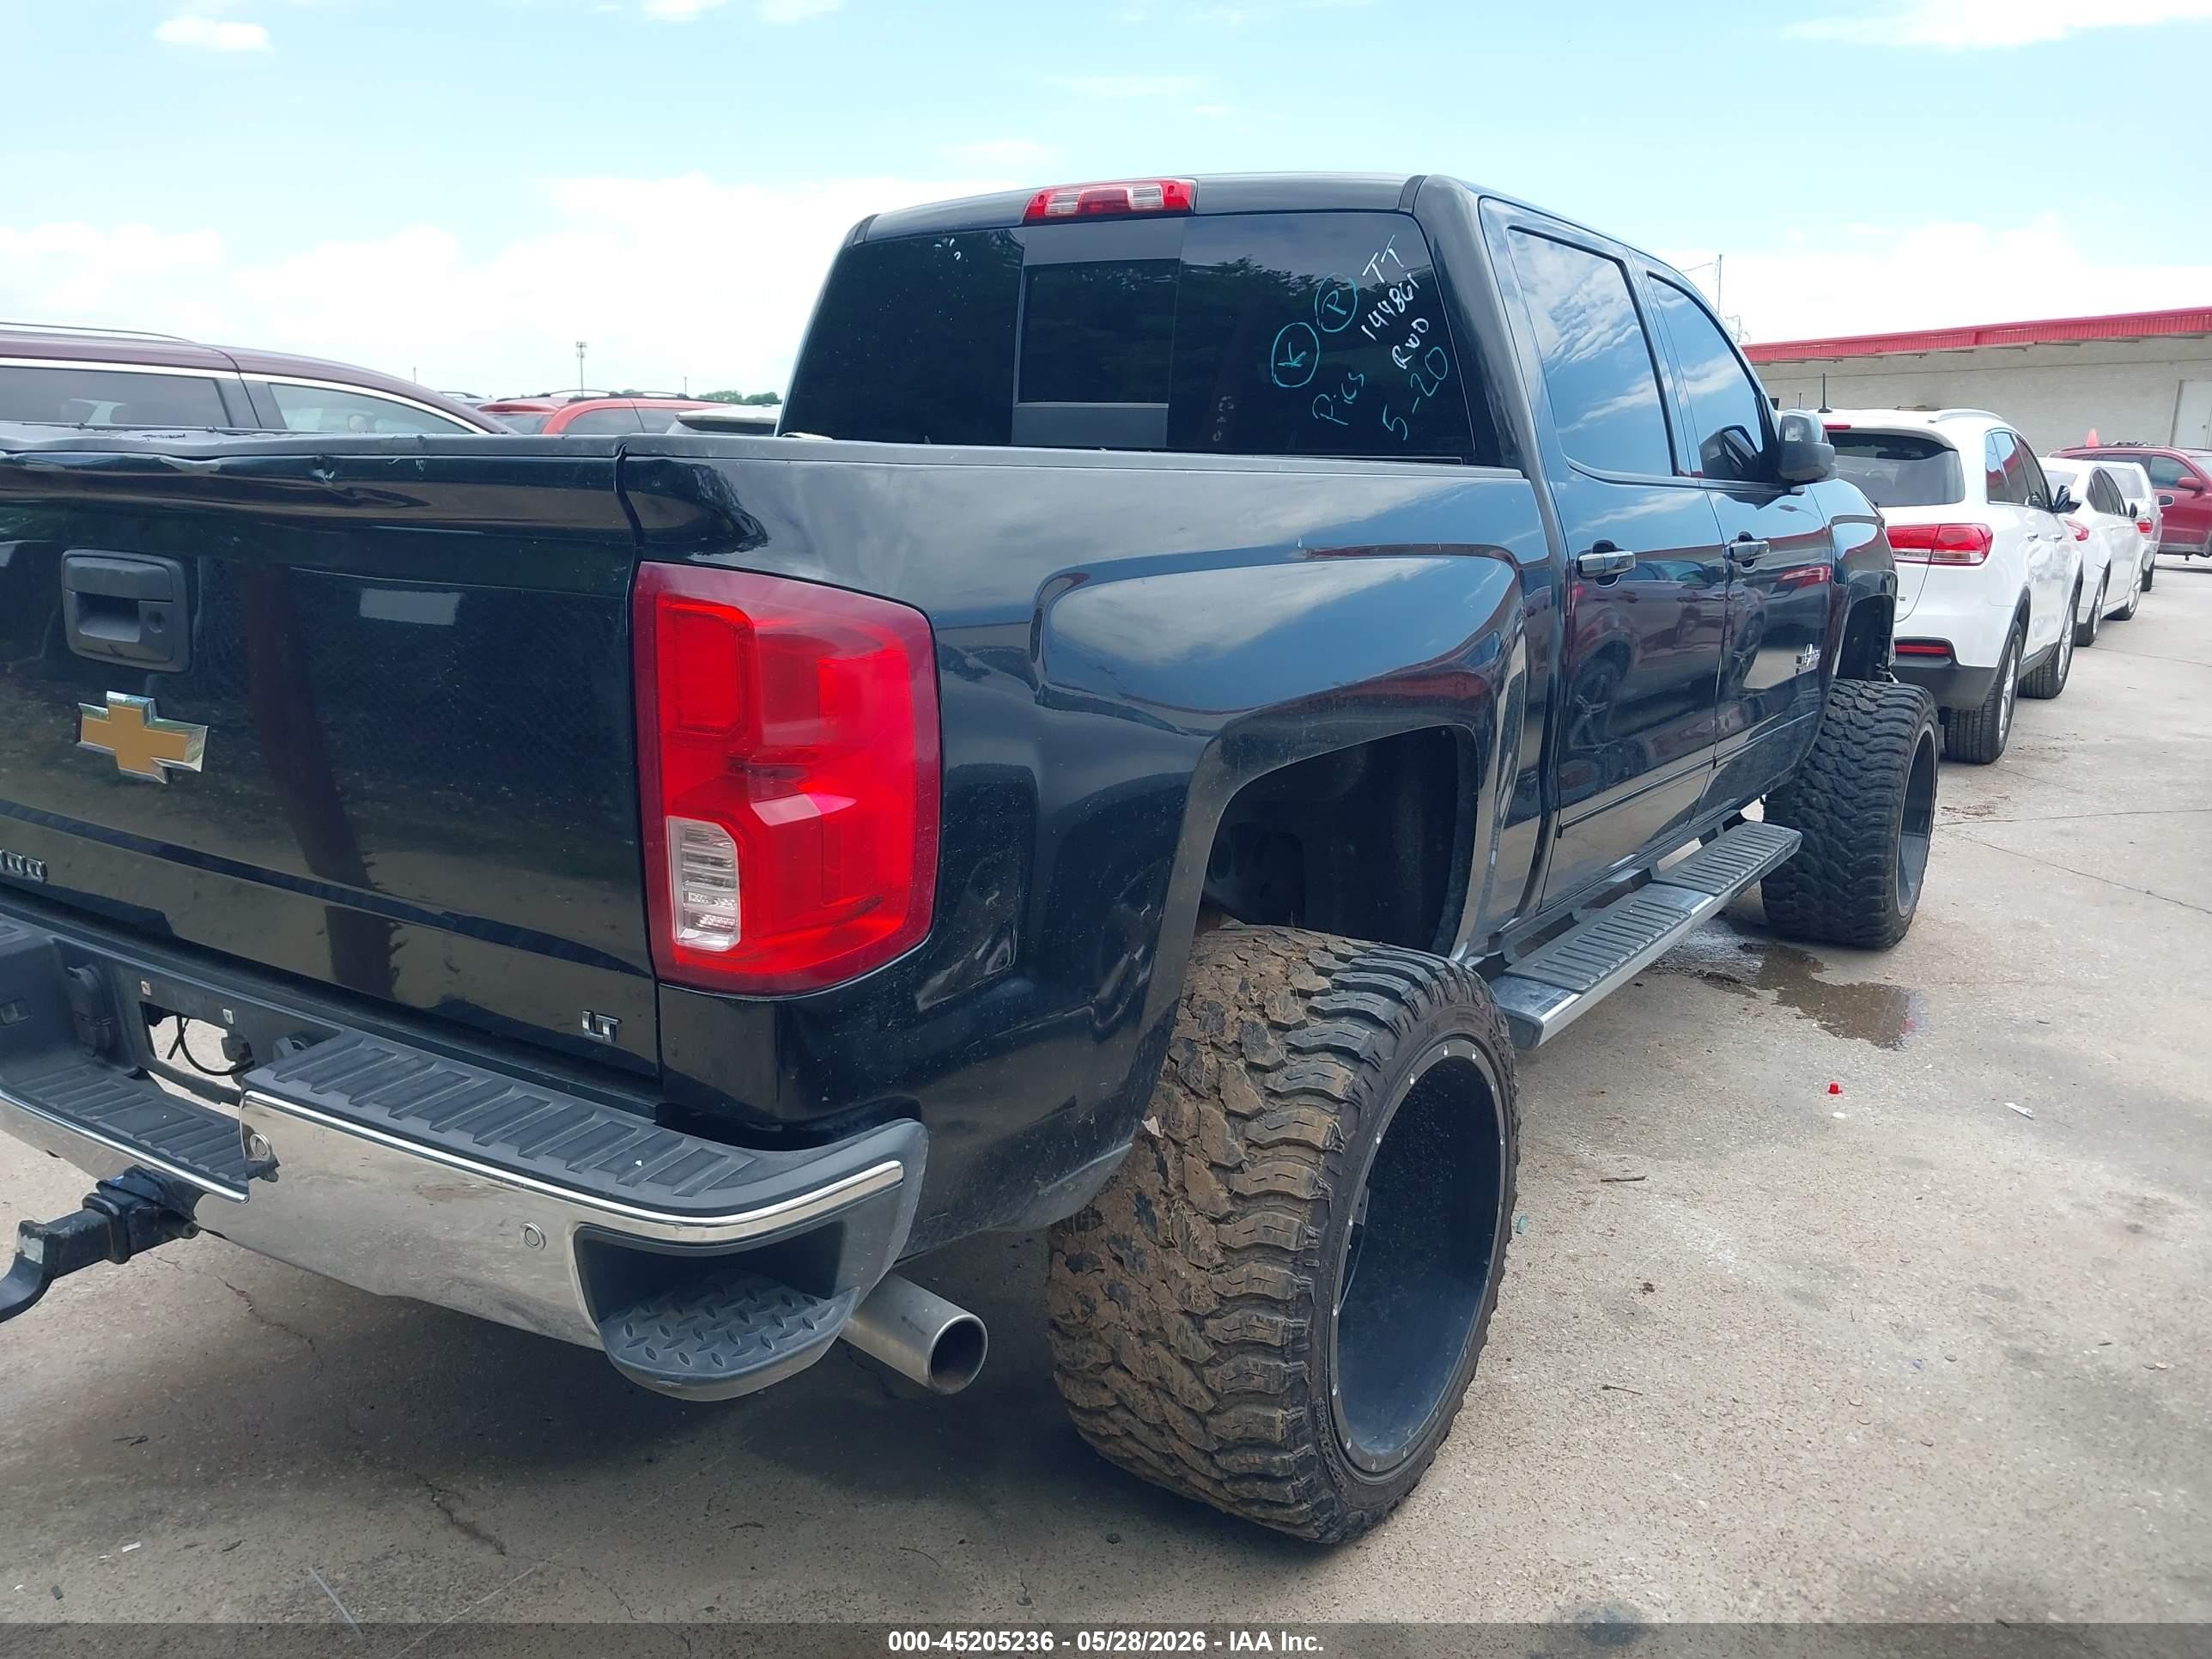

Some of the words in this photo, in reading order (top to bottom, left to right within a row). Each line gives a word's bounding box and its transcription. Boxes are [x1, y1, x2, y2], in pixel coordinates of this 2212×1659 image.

[1362, 234, 1404, 283] TT
[1382, 346, 1448, 440] 5-20
[581, 1010, 619, 1044] LT
